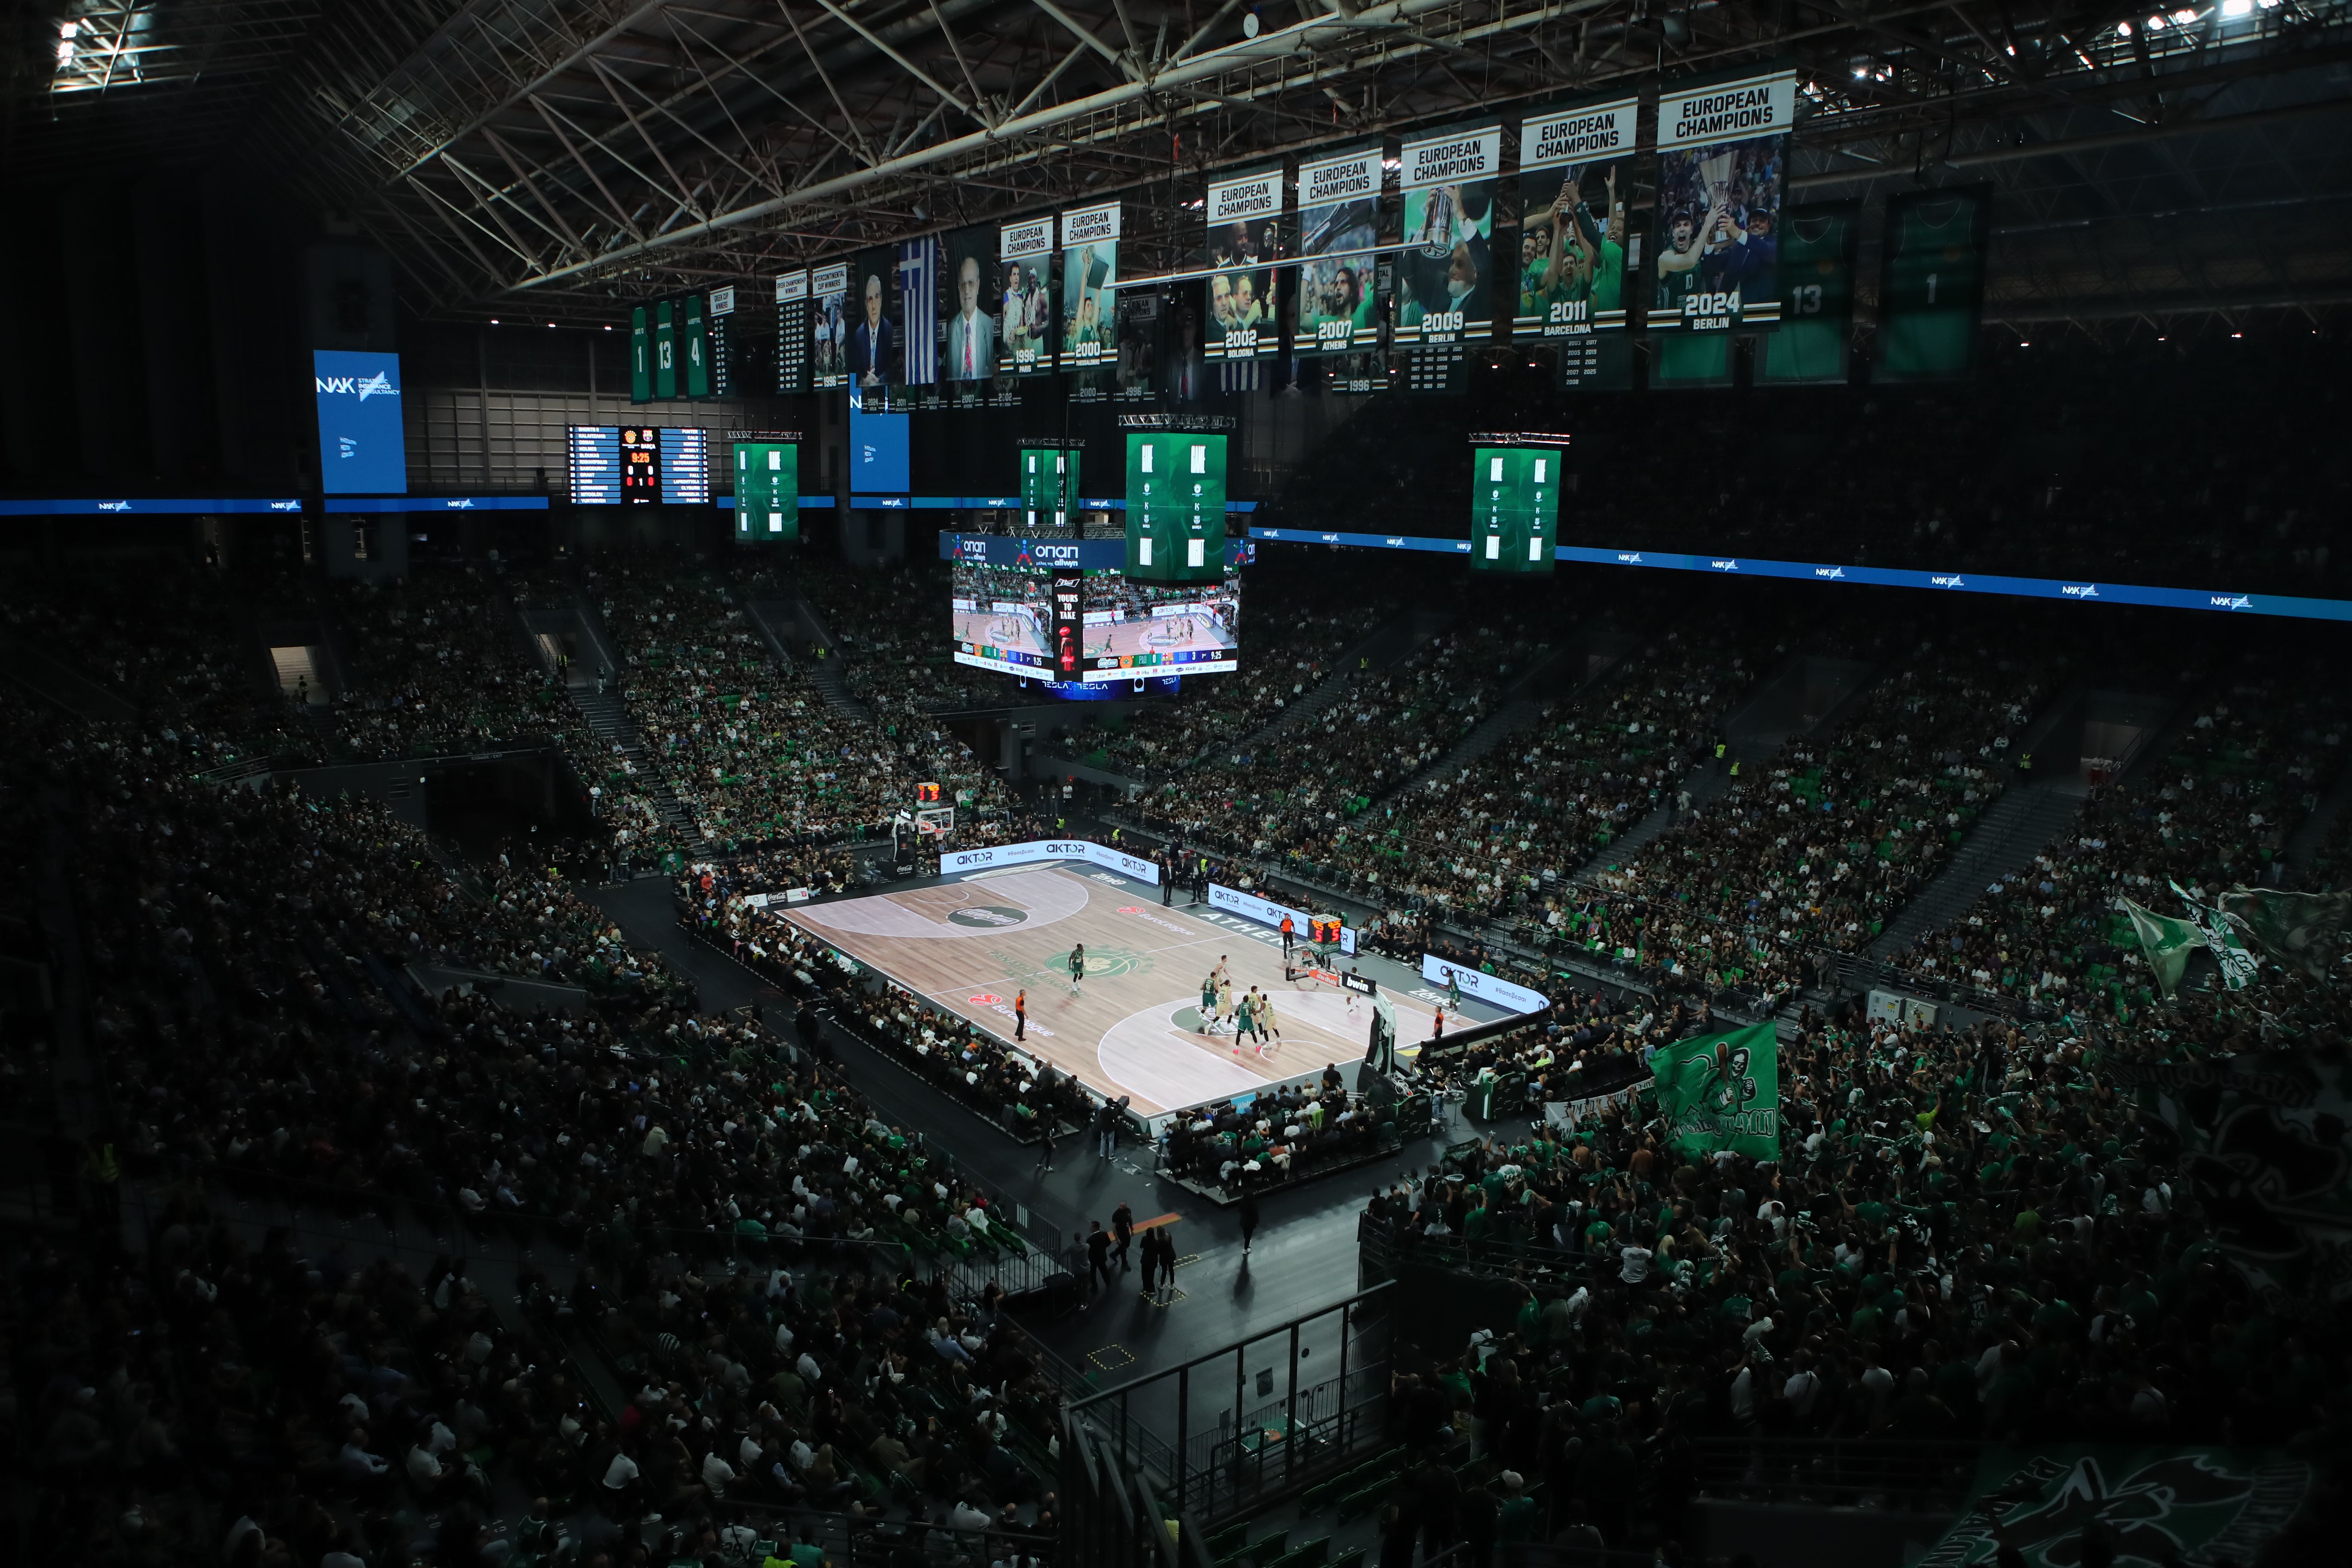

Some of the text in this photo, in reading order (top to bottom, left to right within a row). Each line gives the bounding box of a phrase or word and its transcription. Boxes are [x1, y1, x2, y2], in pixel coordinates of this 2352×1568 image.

[1682, 87, 1769, 118] EUROPEAN
[1541, 113, 1614, 142] EUROPEAN
[1675, 105, 1773, 138] CHAMPIONS
[1536, 131, 1619, 159] CHAMPIONS
[1418, 140, 1481, 165] EUROPEAN
[1313, 161, 1366, 184] EUROPEAN
[1414, 154, 1485, 181] CHAMPIONS
[1221, 182, 1269, 203] EUROPEAN
[1309, 175, 1369, 200] CHAMPIONS
[1217, 196, 1271, 217] CHAMPIONS
[1072, 212, 1109, 228] EUROPEAN
[1010, 226, 1043, 243] EUROPEAN
[1069, 223, 1111, 241] CHAMPIONS
[1007, 236, 1045, 254] CHAMPIONS
[814, 270, 845, 283] INTERCONTINENTAL
[825, 279, 840, 288] WINNERS
[1926, 273, 1937, 304] 1
[714, 293, 723, 302] GREEK
[1685, 291, 1740, 316] 2024
[1793, 284, 1822, 314] 13
[715, 301, 728, 309] WINNERS
[1550, 300, 1587, 322] 2011
[1422, 312, 1463, 332] 2009
[1693, 316, 1729, 330] BERLIN
[1318, 320, 1352, 340] 2007
[1544, 323, 1591, 336] BARCELONA
[1225, 330, 1257, 347] 2002
[1428, 333, 1455, 343] BERLIN
[691, 337, 700, 366] 4
[1076, 341, 1100, 357] 2000
[1322, 340, 1347, 351] ATHENS
[638, 346, 642, 373] 1
[659, 341, 671, 369] 13
[1016, 349, 1035, 364] 1996
[1227, 347, 1254, 359] BOLOGNA
[1019, 365, 1032, 373] PARIS
[1076, 358, 1100, 367] THESSALONIKI
[316, 377, 356, 394] NAK
[824, 377, 836, 387] 1996
[1349, 380, 1370, 392] 1996
[927, 396, 939, 404] 2009
[962, 395, 975, 403] 2007
[632, 453, 650, 463] 9:25
[628, 466, 634, 475] 0
[648, 466, 653, 475] 0
[627, 477, 654, 486] 0 1 0
[1054, 559, 1078, 568] allwyn
[1932, 577, 1948, 585] NAK
[2063, 586, 2080, 595] NAK
[2211, 597, 2232, 606] NAK
[1060, 612, 1076, 620] TAKE
[1020, 653, 1042, 666] 3 9:25
[1152, 654, 1156, 664] 0
[1192, 652, 1196, 660] 3
[1211, 651, 1222, 660] 9:25
[1042, 681, 1069, 689] TESLA
[1162, 677, 1177, 685] TESLA
[919, 791, 925, 800] 5
[931, 791, 939, 800] 5
[901, 809, 911, 820] bwin
[768, 892, 786, 900] Coca-Cola
[1138, 912, 1195, 937] EuroLeague
[1199, 913, 1297, 947] ATHEN
[1315, 930, 1323, 943] 5
[1332, 929, 1340, 942] 5
[1325, 976, 1337, 986] dhabi
[1347, 976, 1369, 992] bwin
